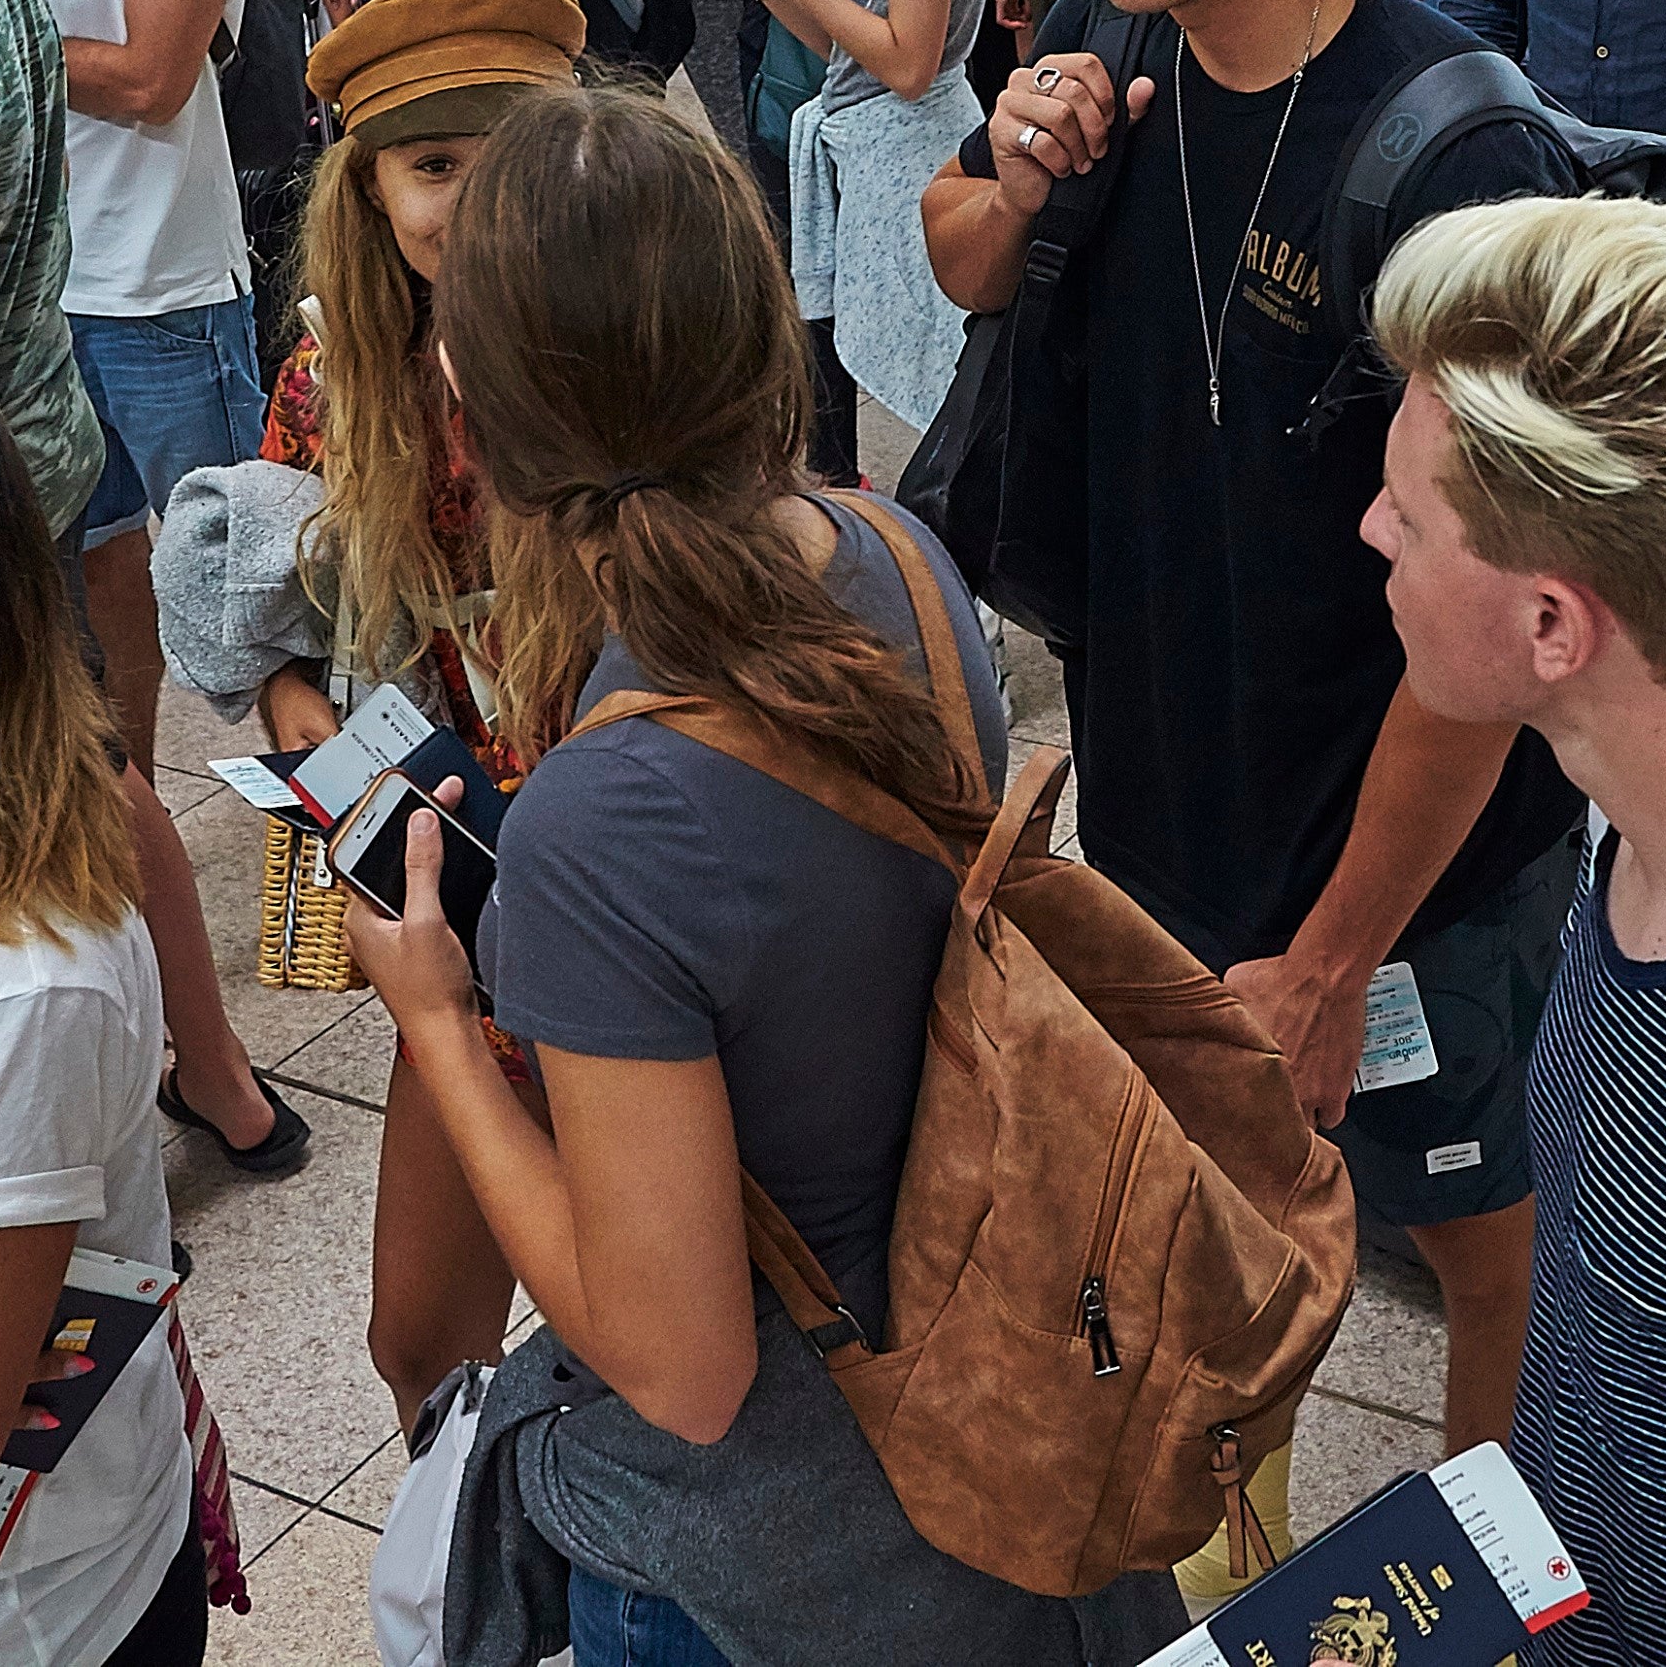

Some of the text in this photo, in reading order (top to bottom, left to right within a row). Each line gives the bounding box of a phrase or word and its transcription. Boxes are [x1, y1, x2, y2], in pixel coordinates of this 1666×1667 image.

[1383, 1564, 1432, 1636] United States
[1398, 1562, 1440, 1620] of America
